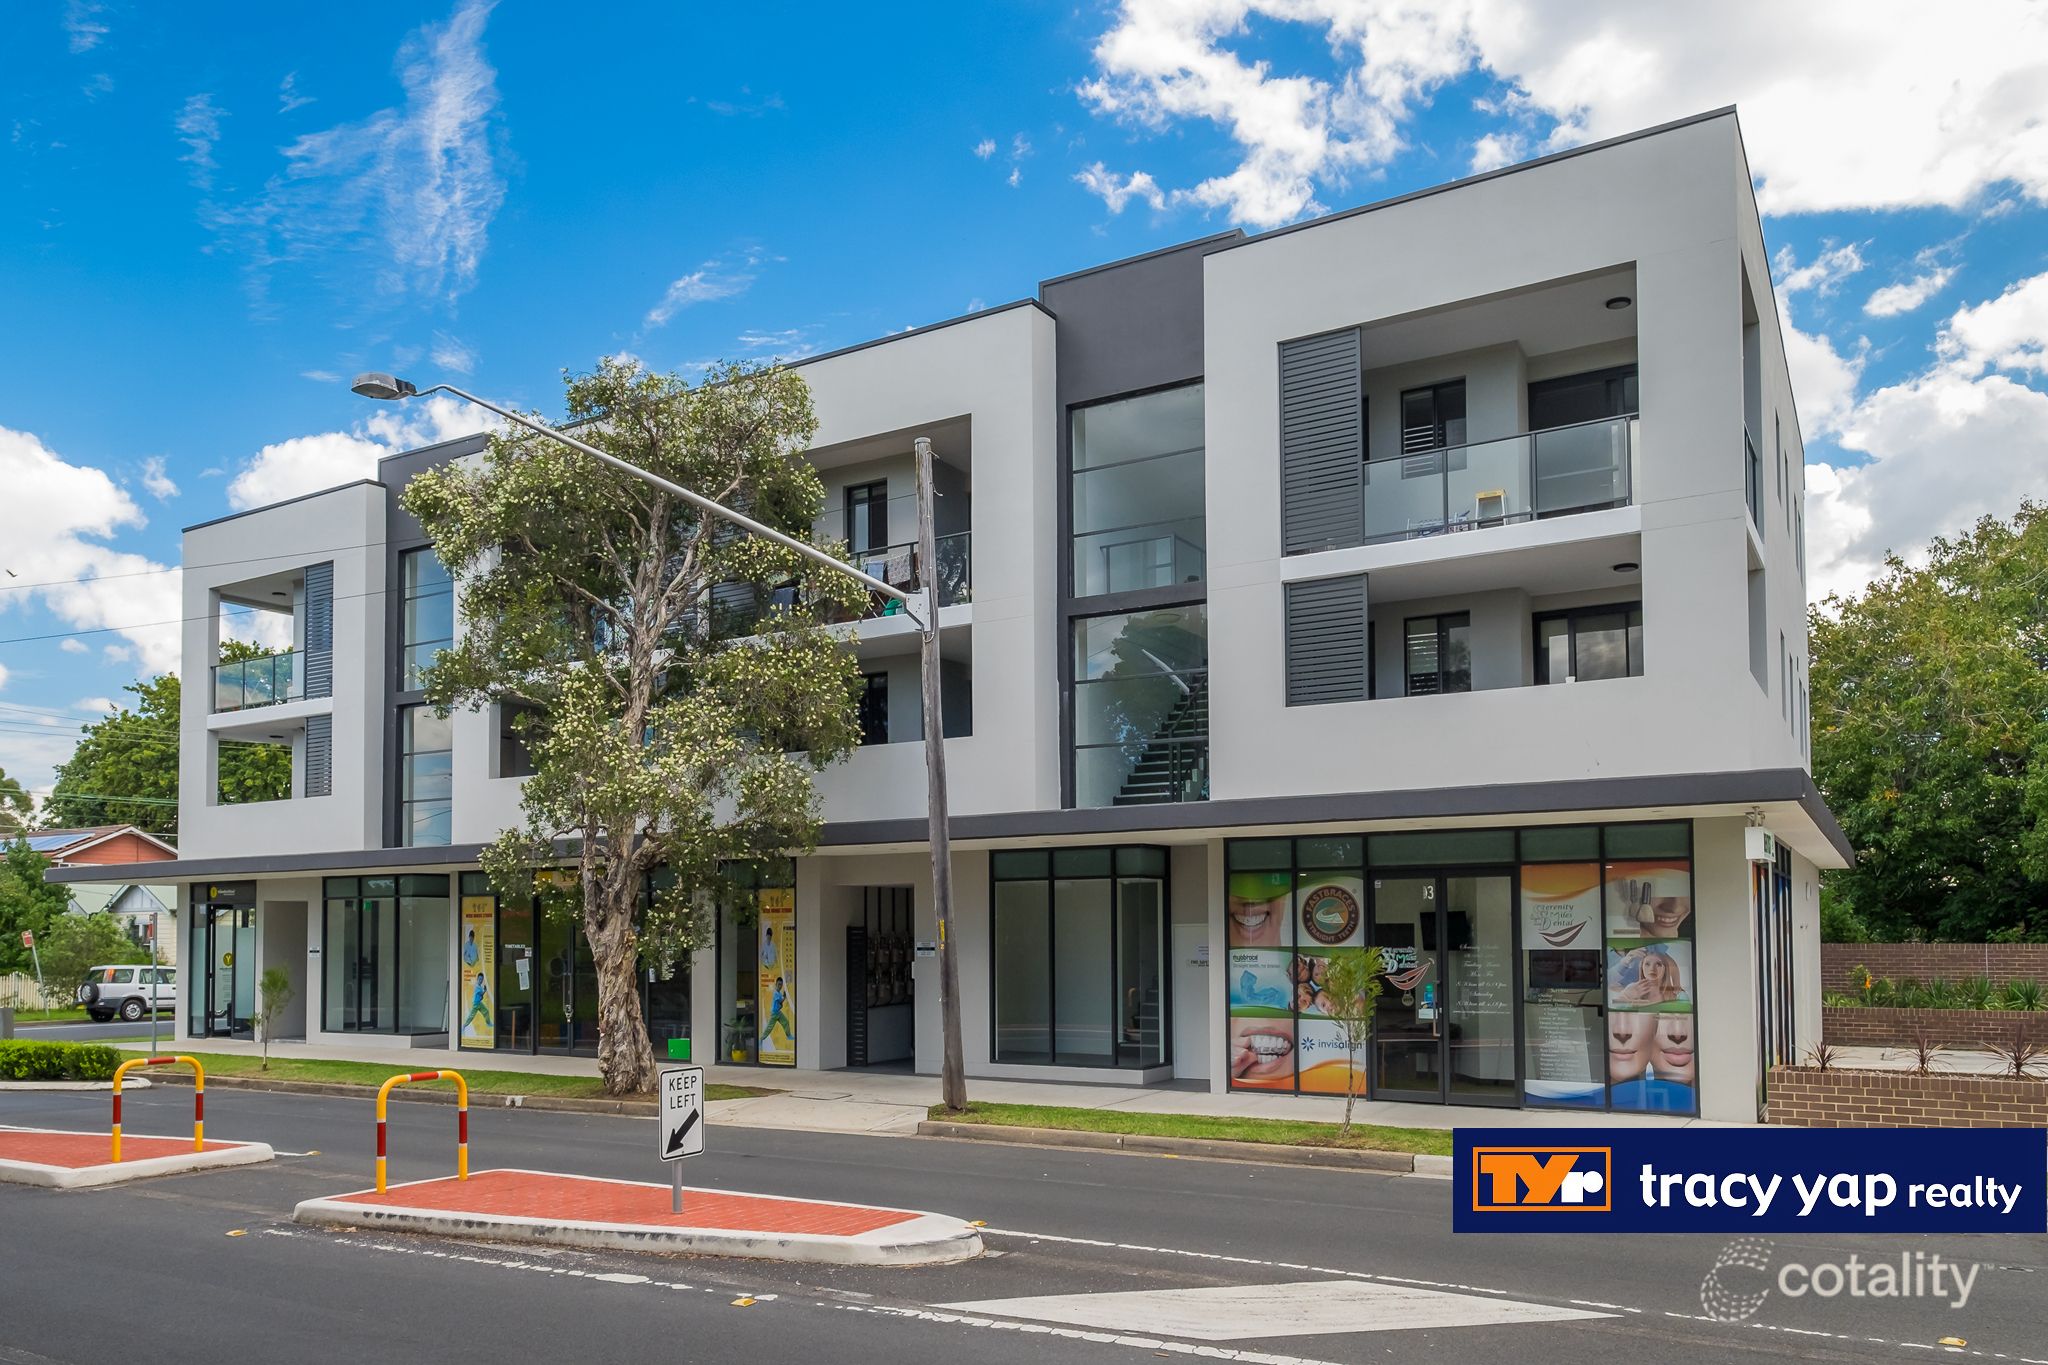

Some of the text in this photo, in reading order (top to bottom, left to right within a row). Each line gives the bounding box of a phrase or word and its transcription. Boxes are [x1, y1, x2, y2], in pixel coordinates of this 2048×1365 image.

[1306, 888, 1356, 912] FASTBRACES
[1318, 1038, 1363, 1052] invisalign
[669, 1075, 697, 1092] KEEP
[670, 1093, 696, 1110] LEFT
